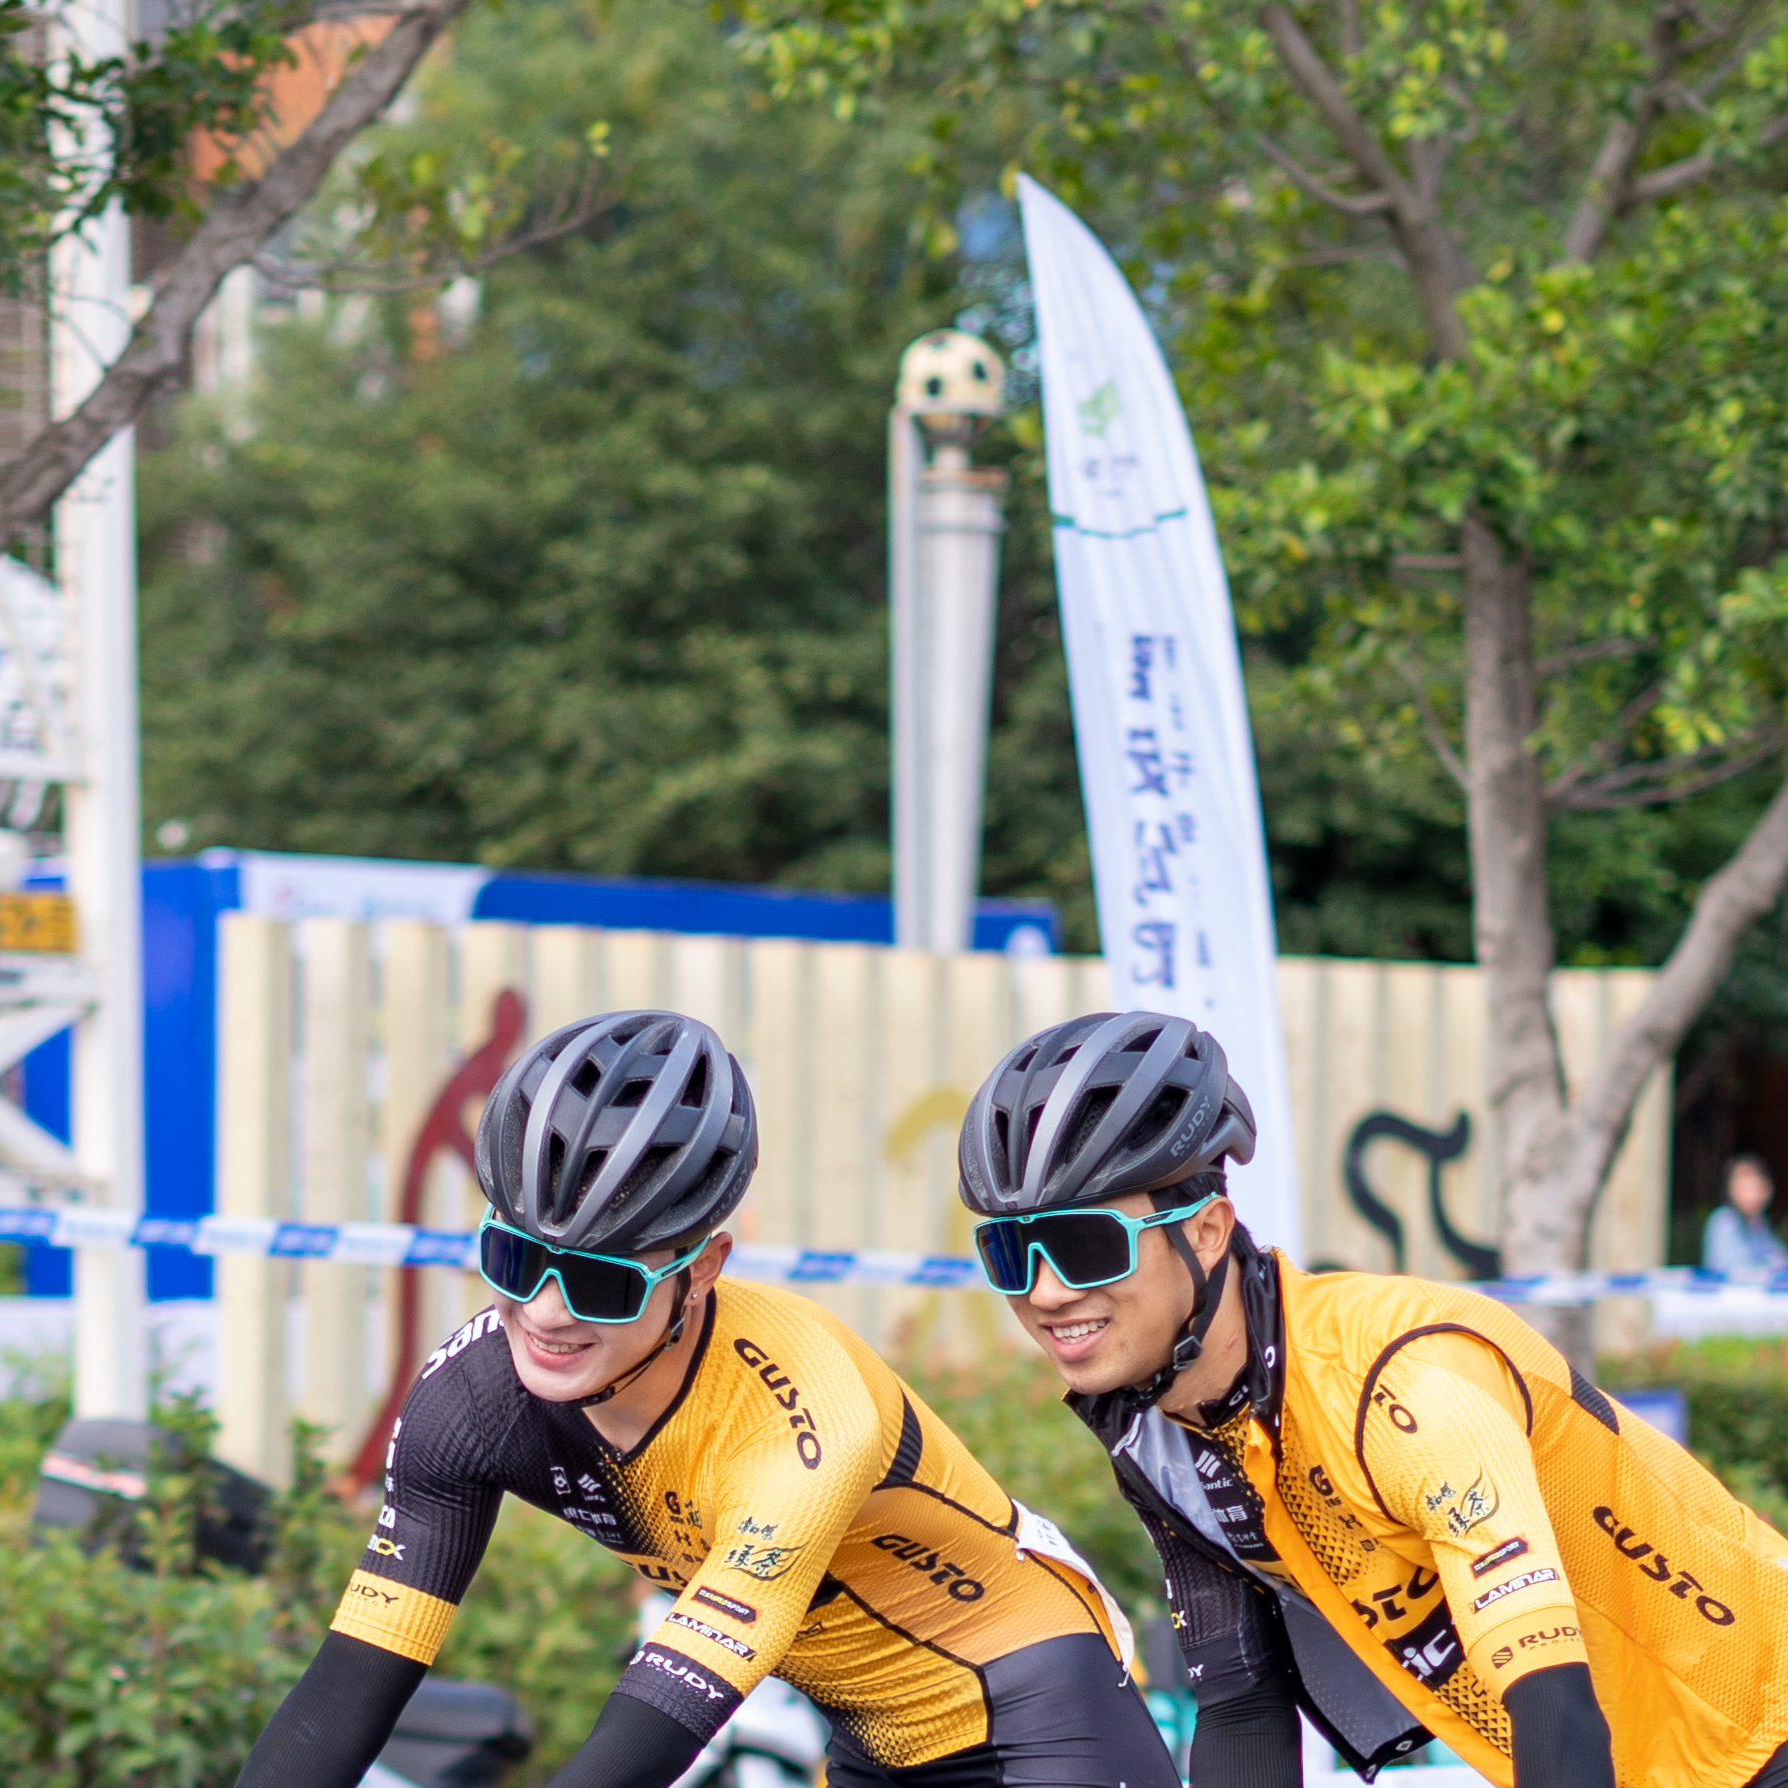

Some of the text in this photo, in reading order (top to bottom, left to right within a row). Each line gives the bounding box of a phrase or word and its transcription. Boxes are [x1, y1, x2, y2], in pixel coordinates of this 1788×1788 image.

[1170, 1095, 1210, 1157] RUDY
[733, 1337, 823, 1471] GUSTO
[871, 1533, 985, 1602] GUSTO
[1592, 1505, 1736, 1627] GUSTO
[645, 1653, 725, 1701] RUDY
